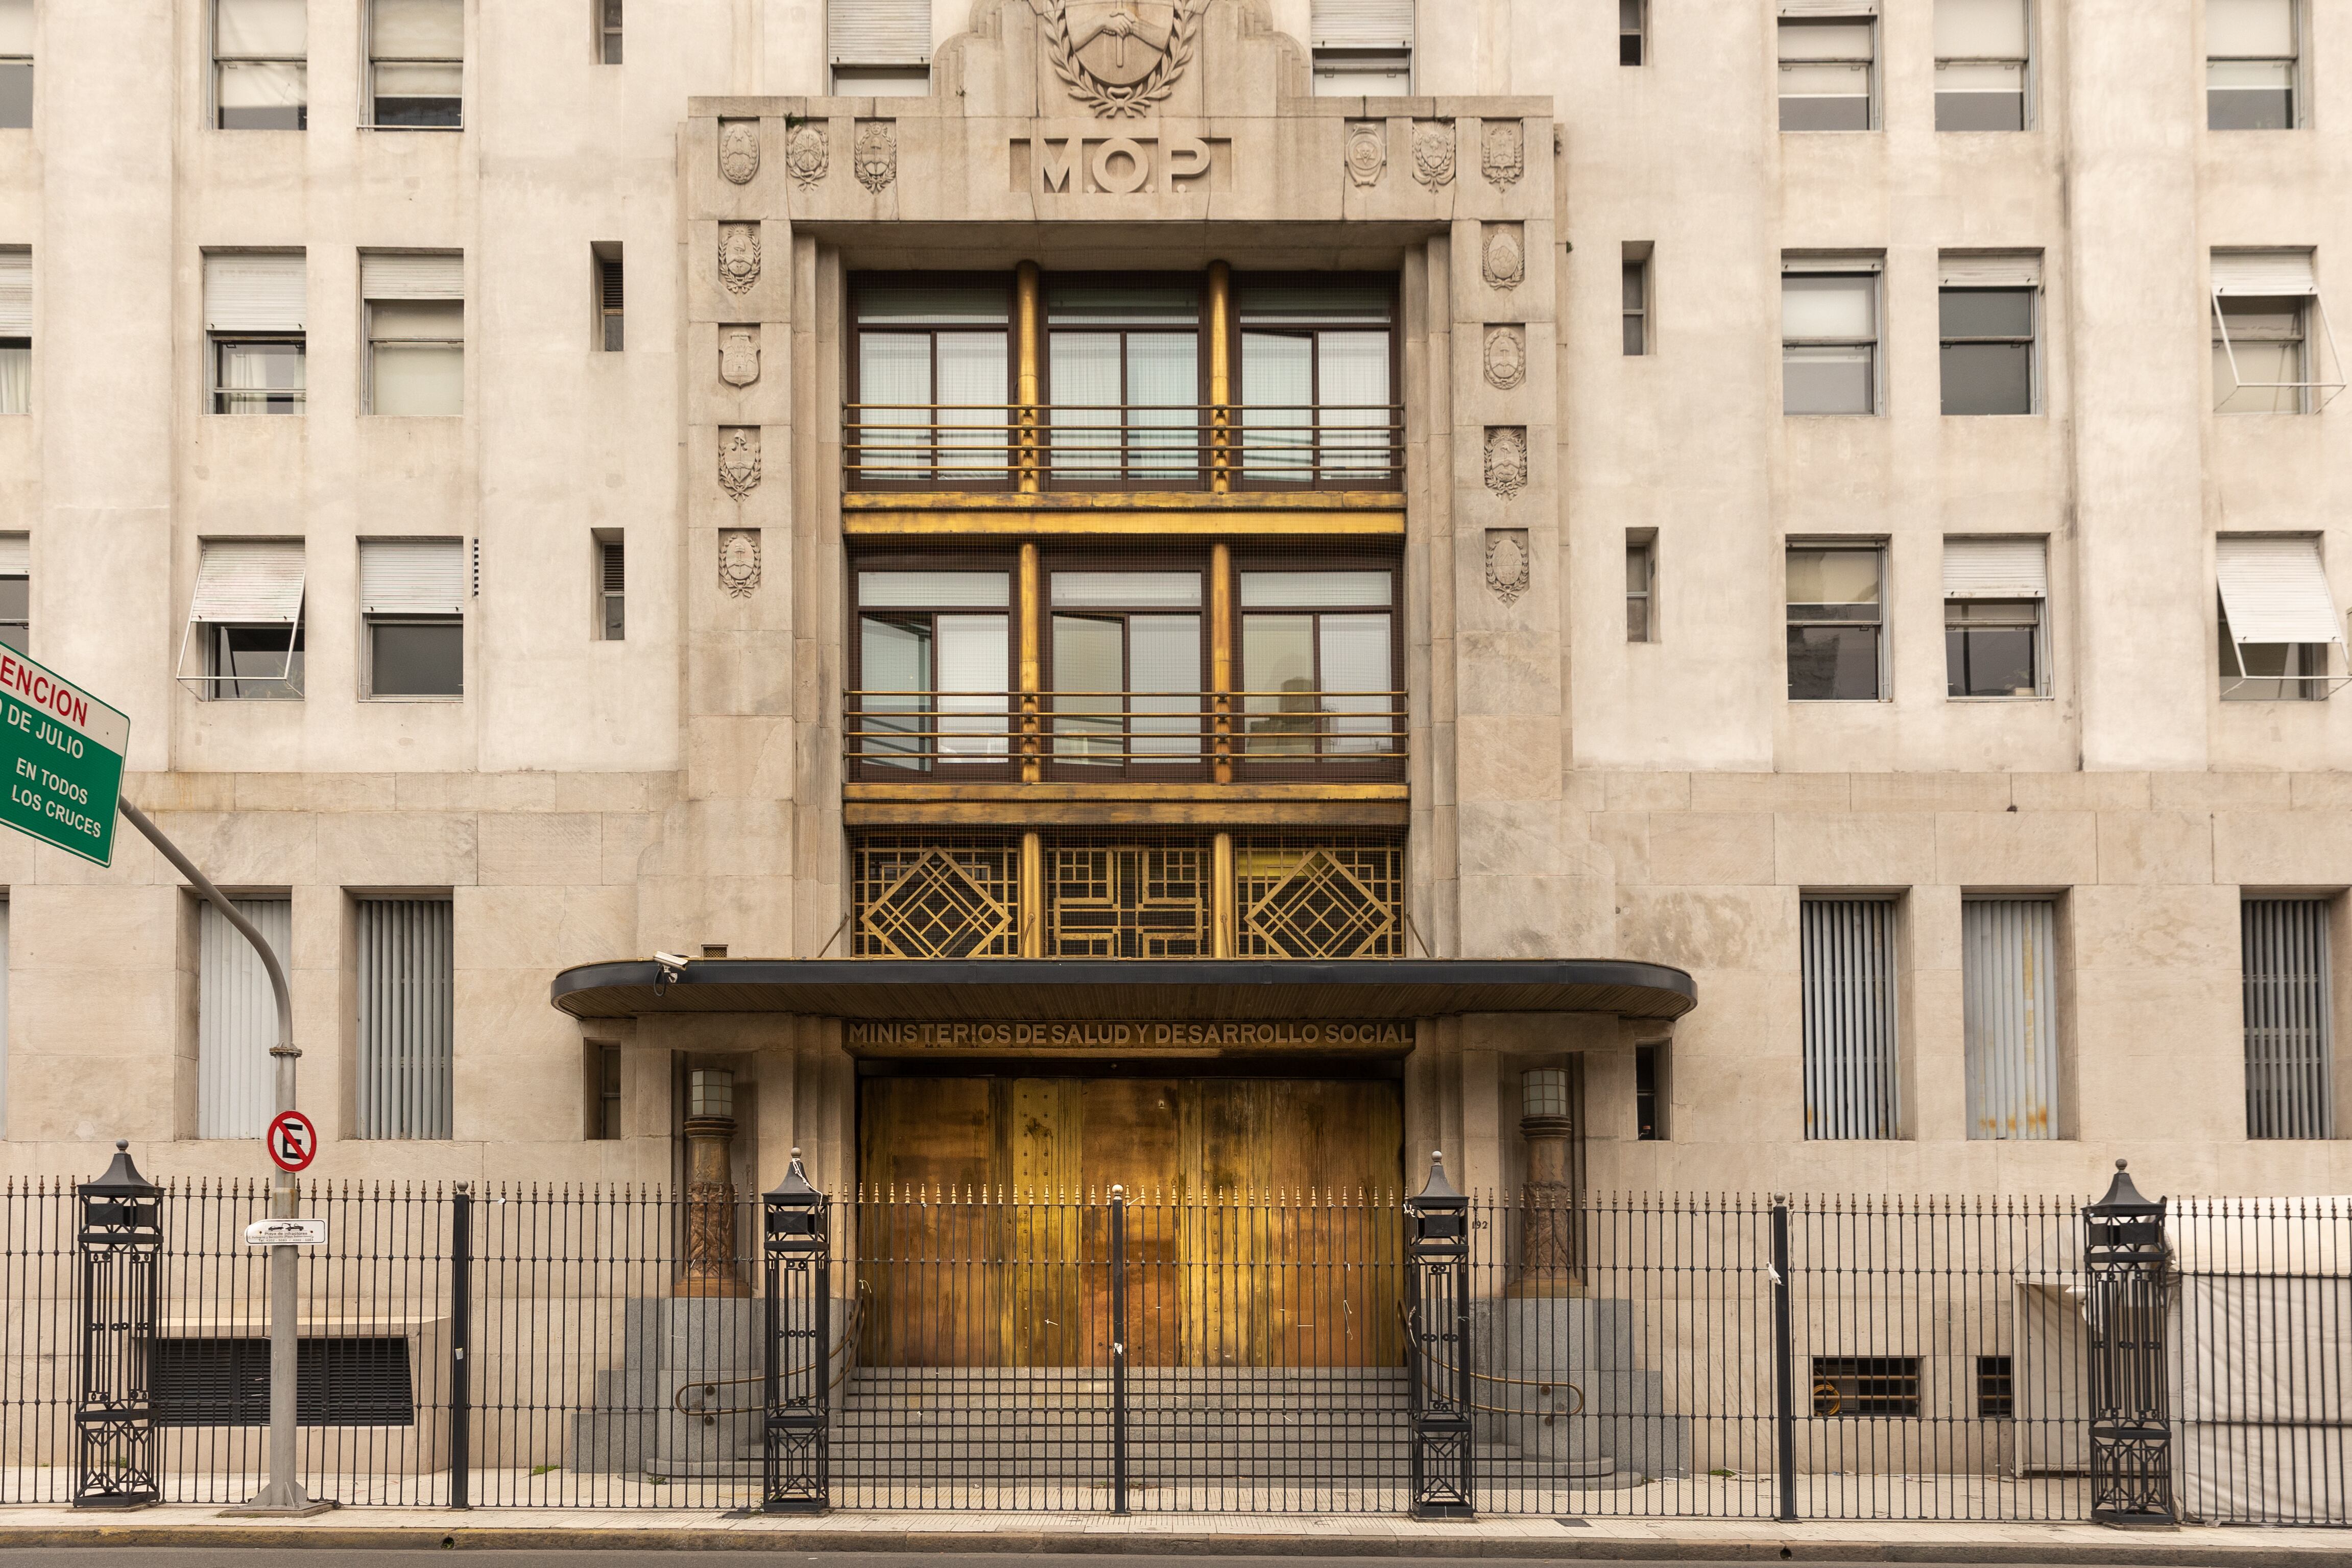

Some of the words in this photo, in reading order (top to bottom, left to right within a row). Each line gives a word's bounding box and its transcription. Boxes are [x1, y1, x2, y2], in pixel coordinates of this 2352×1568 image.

[0, 653, 87, 727] ENCION
[7, 704, 32, 733] DE
[35, 721, 84, 759] JULIO
[16, 757, 37, 781] EN
[41, 768, 88, 805] TODOS
[11, 784, 42, 811] LOS
[45, 800, 101, 838] CRUCES
[849, 1023, 1011, 1043] MINISTERIOS
[1015, 1023, 1047, 1043] DE
[1050, 1023, 1131, 1043] SALUD
[1135, 1023, 1150, 1043] Y
[1155, 1023, 1319, 1043] DESARROLLO
[1325, 1023, 1414, 1043] SOCIAL
[1472, 1221, 1487, 1229] 192
